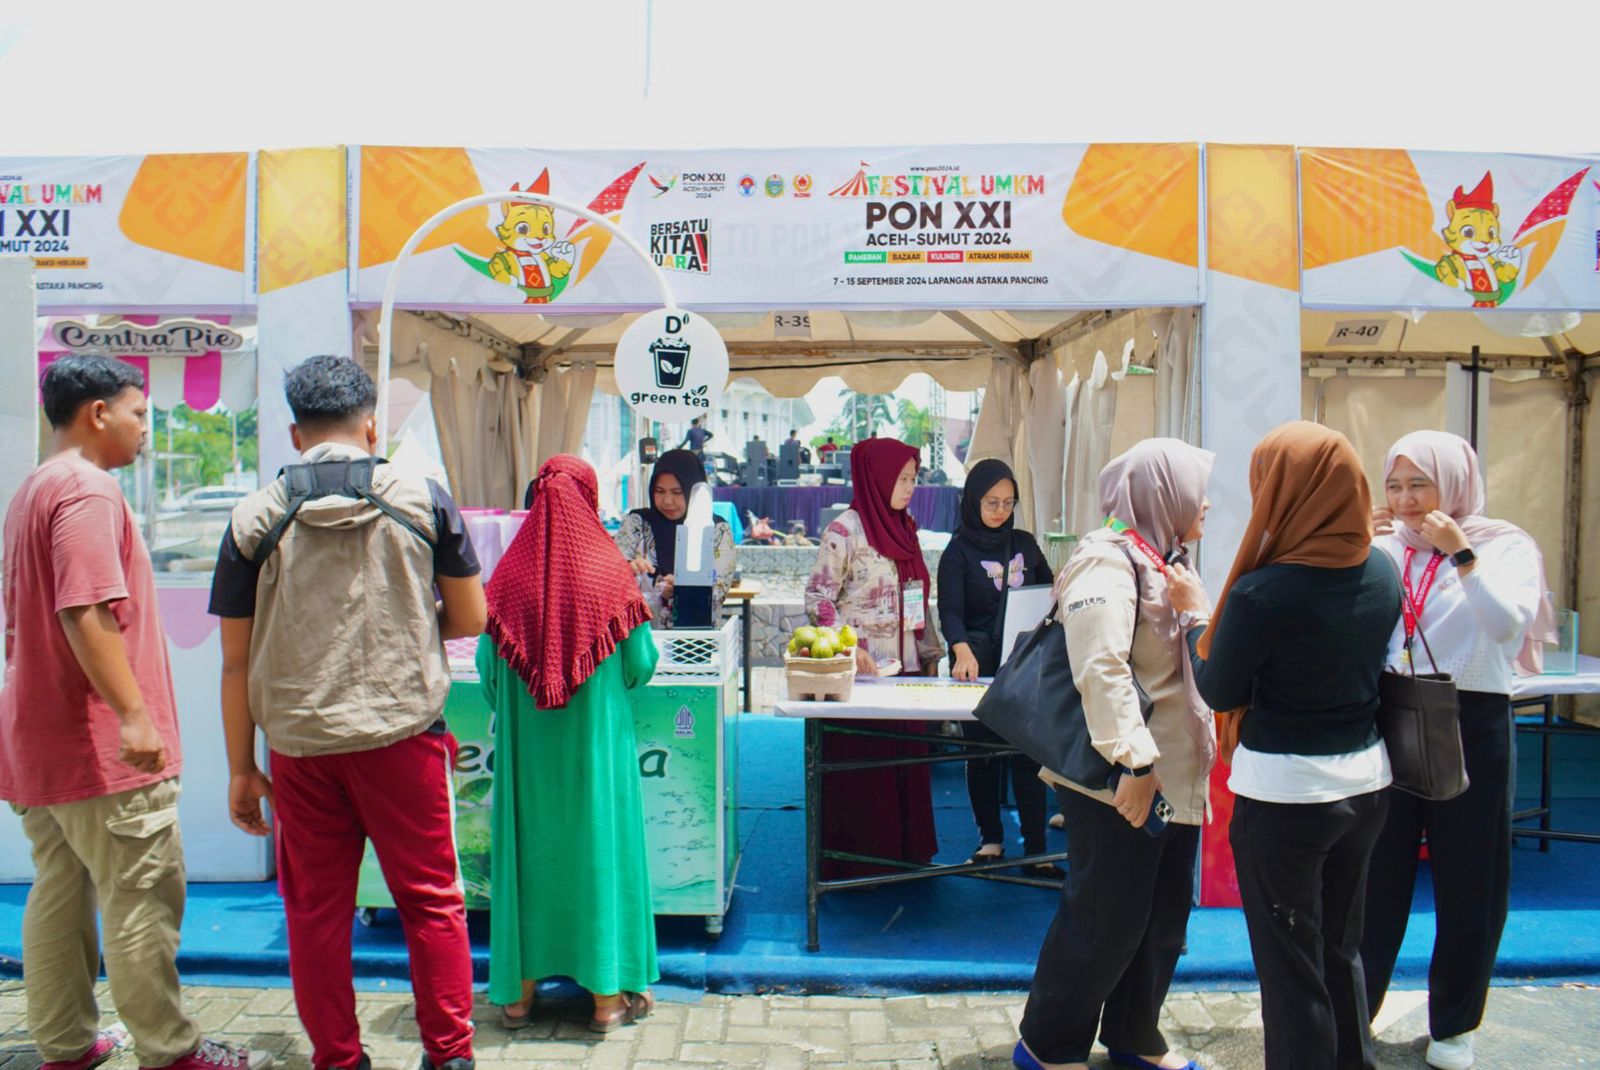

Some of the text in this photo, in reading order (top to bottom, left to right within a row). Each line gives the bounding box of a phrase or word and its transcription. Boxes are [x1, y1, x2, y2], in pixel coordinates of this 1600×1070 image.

[682, 173, 726, 182] PON XXI
[867, 175, 1044, 197] FESTIVAL UMKM
[42, 184, 102, 204] UMKM
[15, 209, 70, 237] XXI
[866, 201, 1012, 231] PON XXI
[651, 218, 708, 235] BERSATU
[34, 240, 70, 252] 2024
[651, 234, 698, 255] KITA
[866, 232, 1012, 247] ACEH-SUMUT 2024
[848, 253, 882, 261] PAMERAN
[931, 252, 960, 260] KULINER
[968, 252, 997, 260] ATRAKSI
[998, 252, 1030, 260] HIBURAN
[833, 277, 838, 286] 7
[847, 277, 855, 285] 15
[857, 277, 905, 286] SEPTEMBER
[906, 277, 927, 285] 2024
[928, 276, 974, 285] LAPANGAN
[975, 276, 1009, 285] ASTAKA
[1010, 276, 1049, 285] PANCING
[60, 326, 236, 348] Centra Pie
[1336, 325, 1379, 338] R-40
[631, 391, 710, 408] green tea
